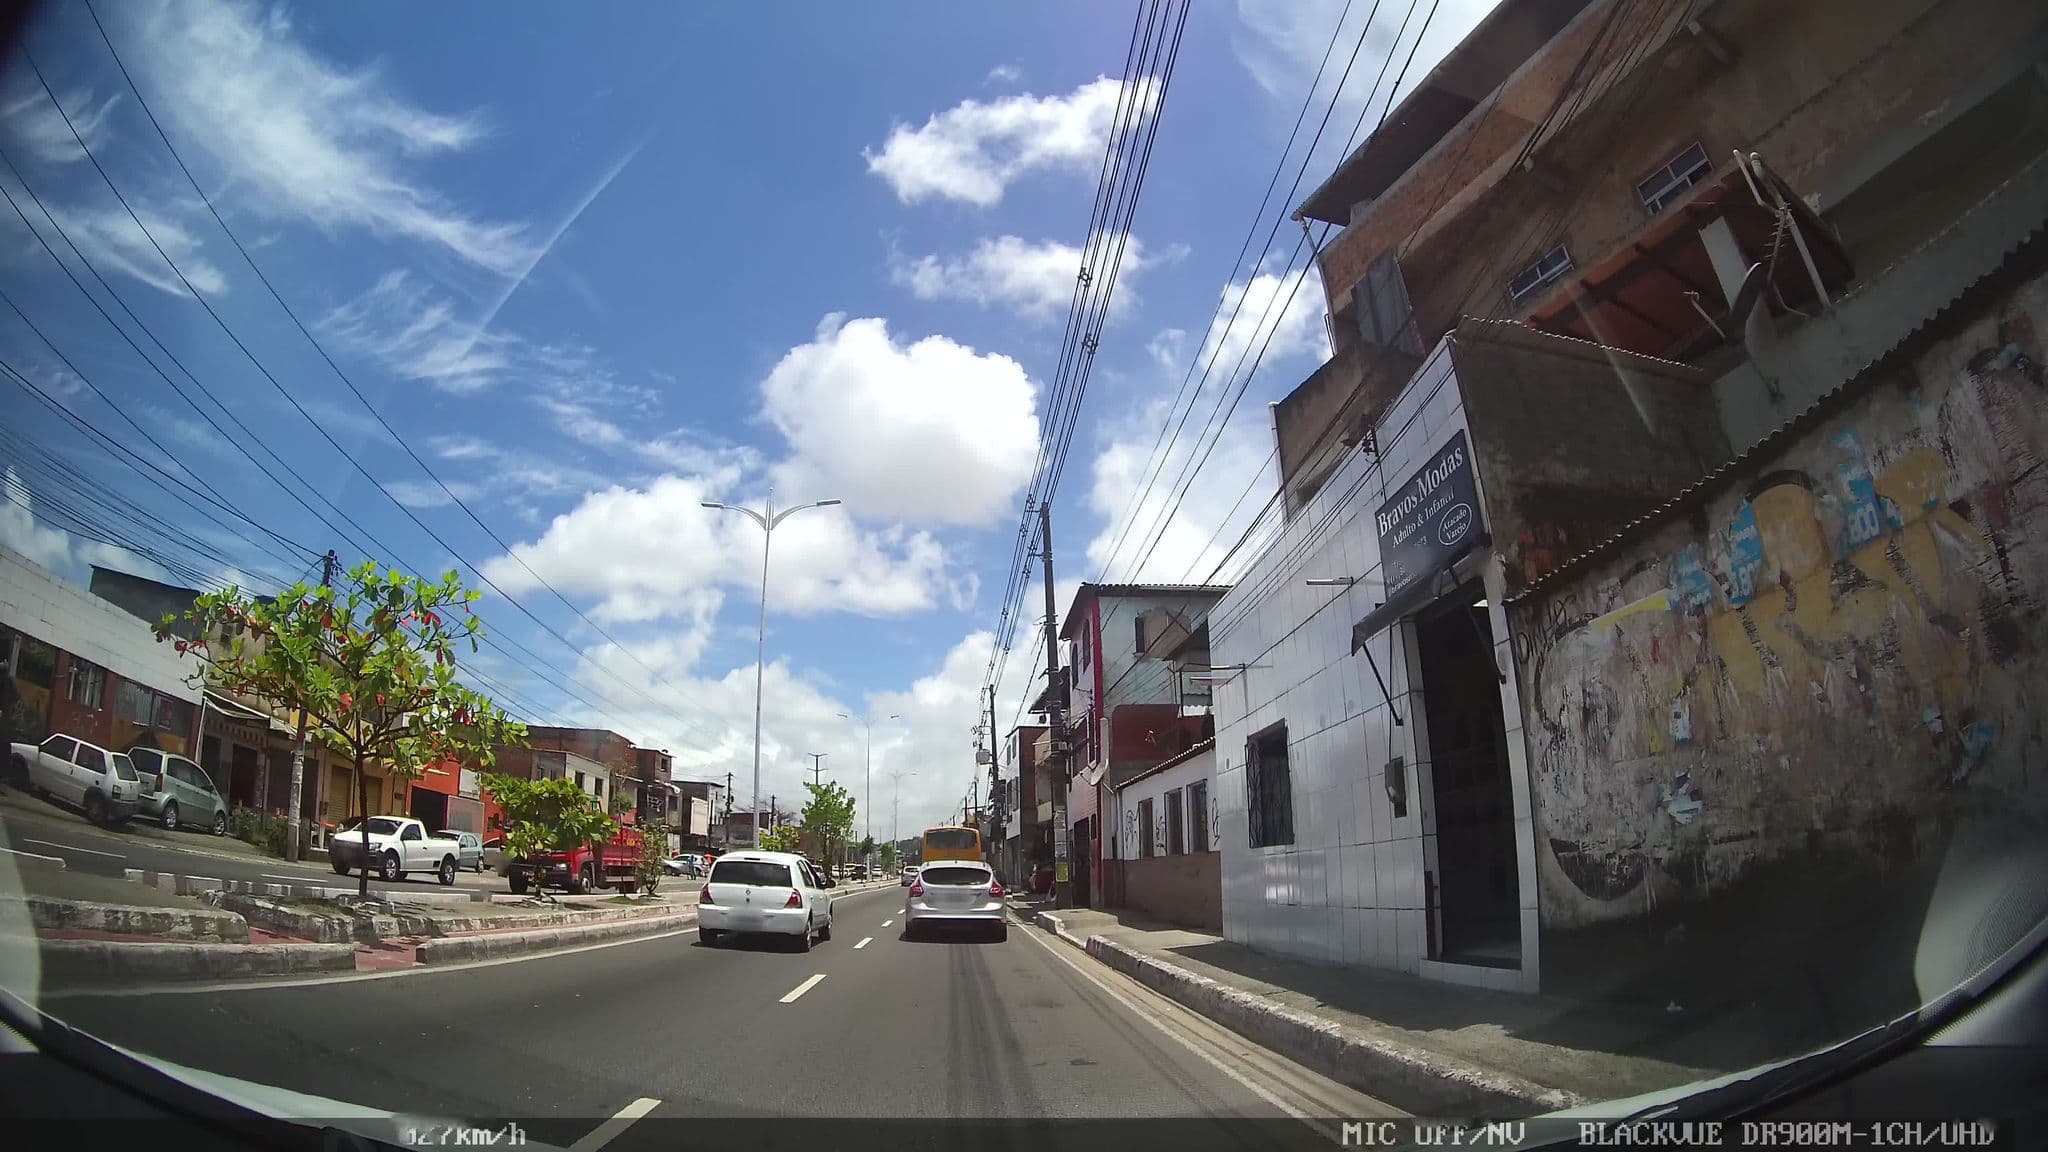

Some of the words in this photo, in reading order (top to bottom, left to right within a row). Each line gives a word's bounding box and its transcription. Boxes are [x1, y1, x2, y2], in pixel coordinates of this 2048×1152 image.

[1377, 494, 1418, 538] Bravos
[1416, 447, 1464, 504] Modas
[1392, 519, 1416, 549] Adulto
[1416, 513, 1425, 528] &
[1442, 508, 1468, 533] Atacado
[1446, 522, 1467, 542] Varejo
